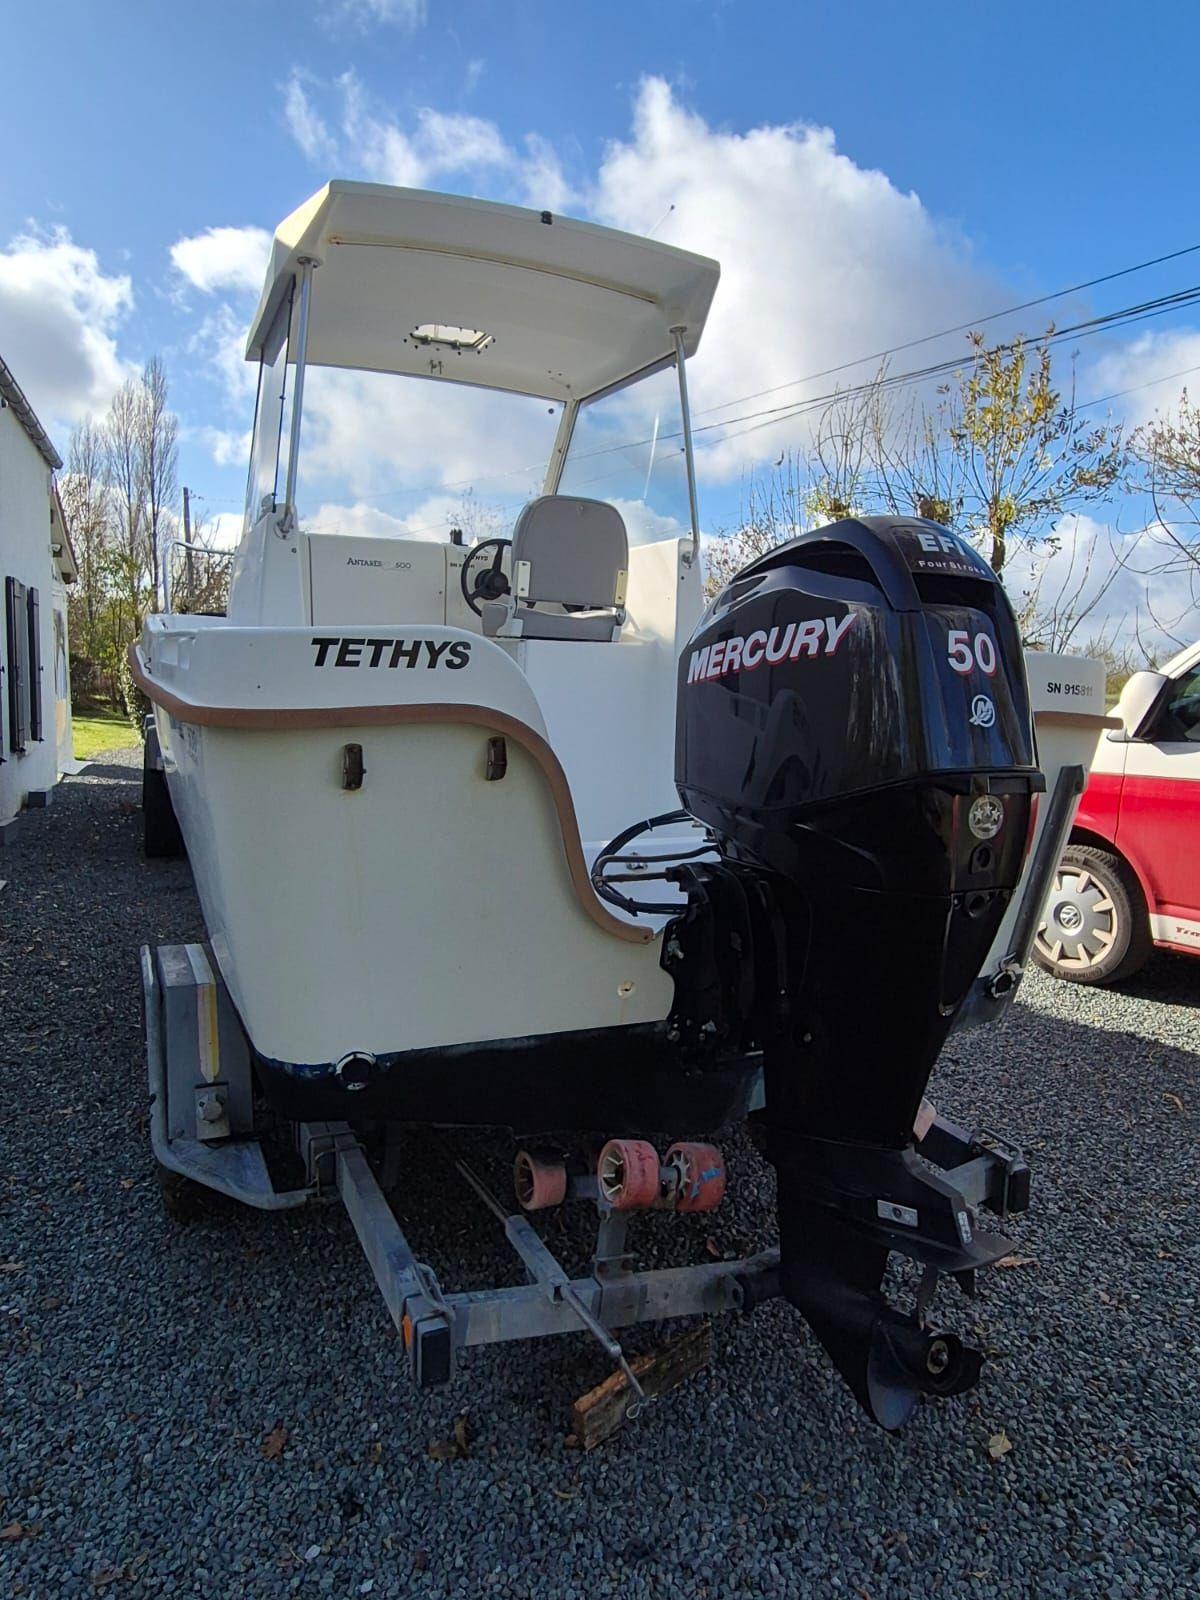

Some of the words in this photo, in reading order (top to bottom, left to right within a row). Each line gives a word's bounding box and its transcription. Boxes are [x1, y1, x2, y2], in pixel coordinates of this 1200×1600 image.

[918, 533, 966, 556] EFI
[311, 637, 472, 670] TETHYS
[686, 613, 857, 685] MERCURY
[947, 630, 998, 677] 50
[1047, 682, 1061, 694] SN
